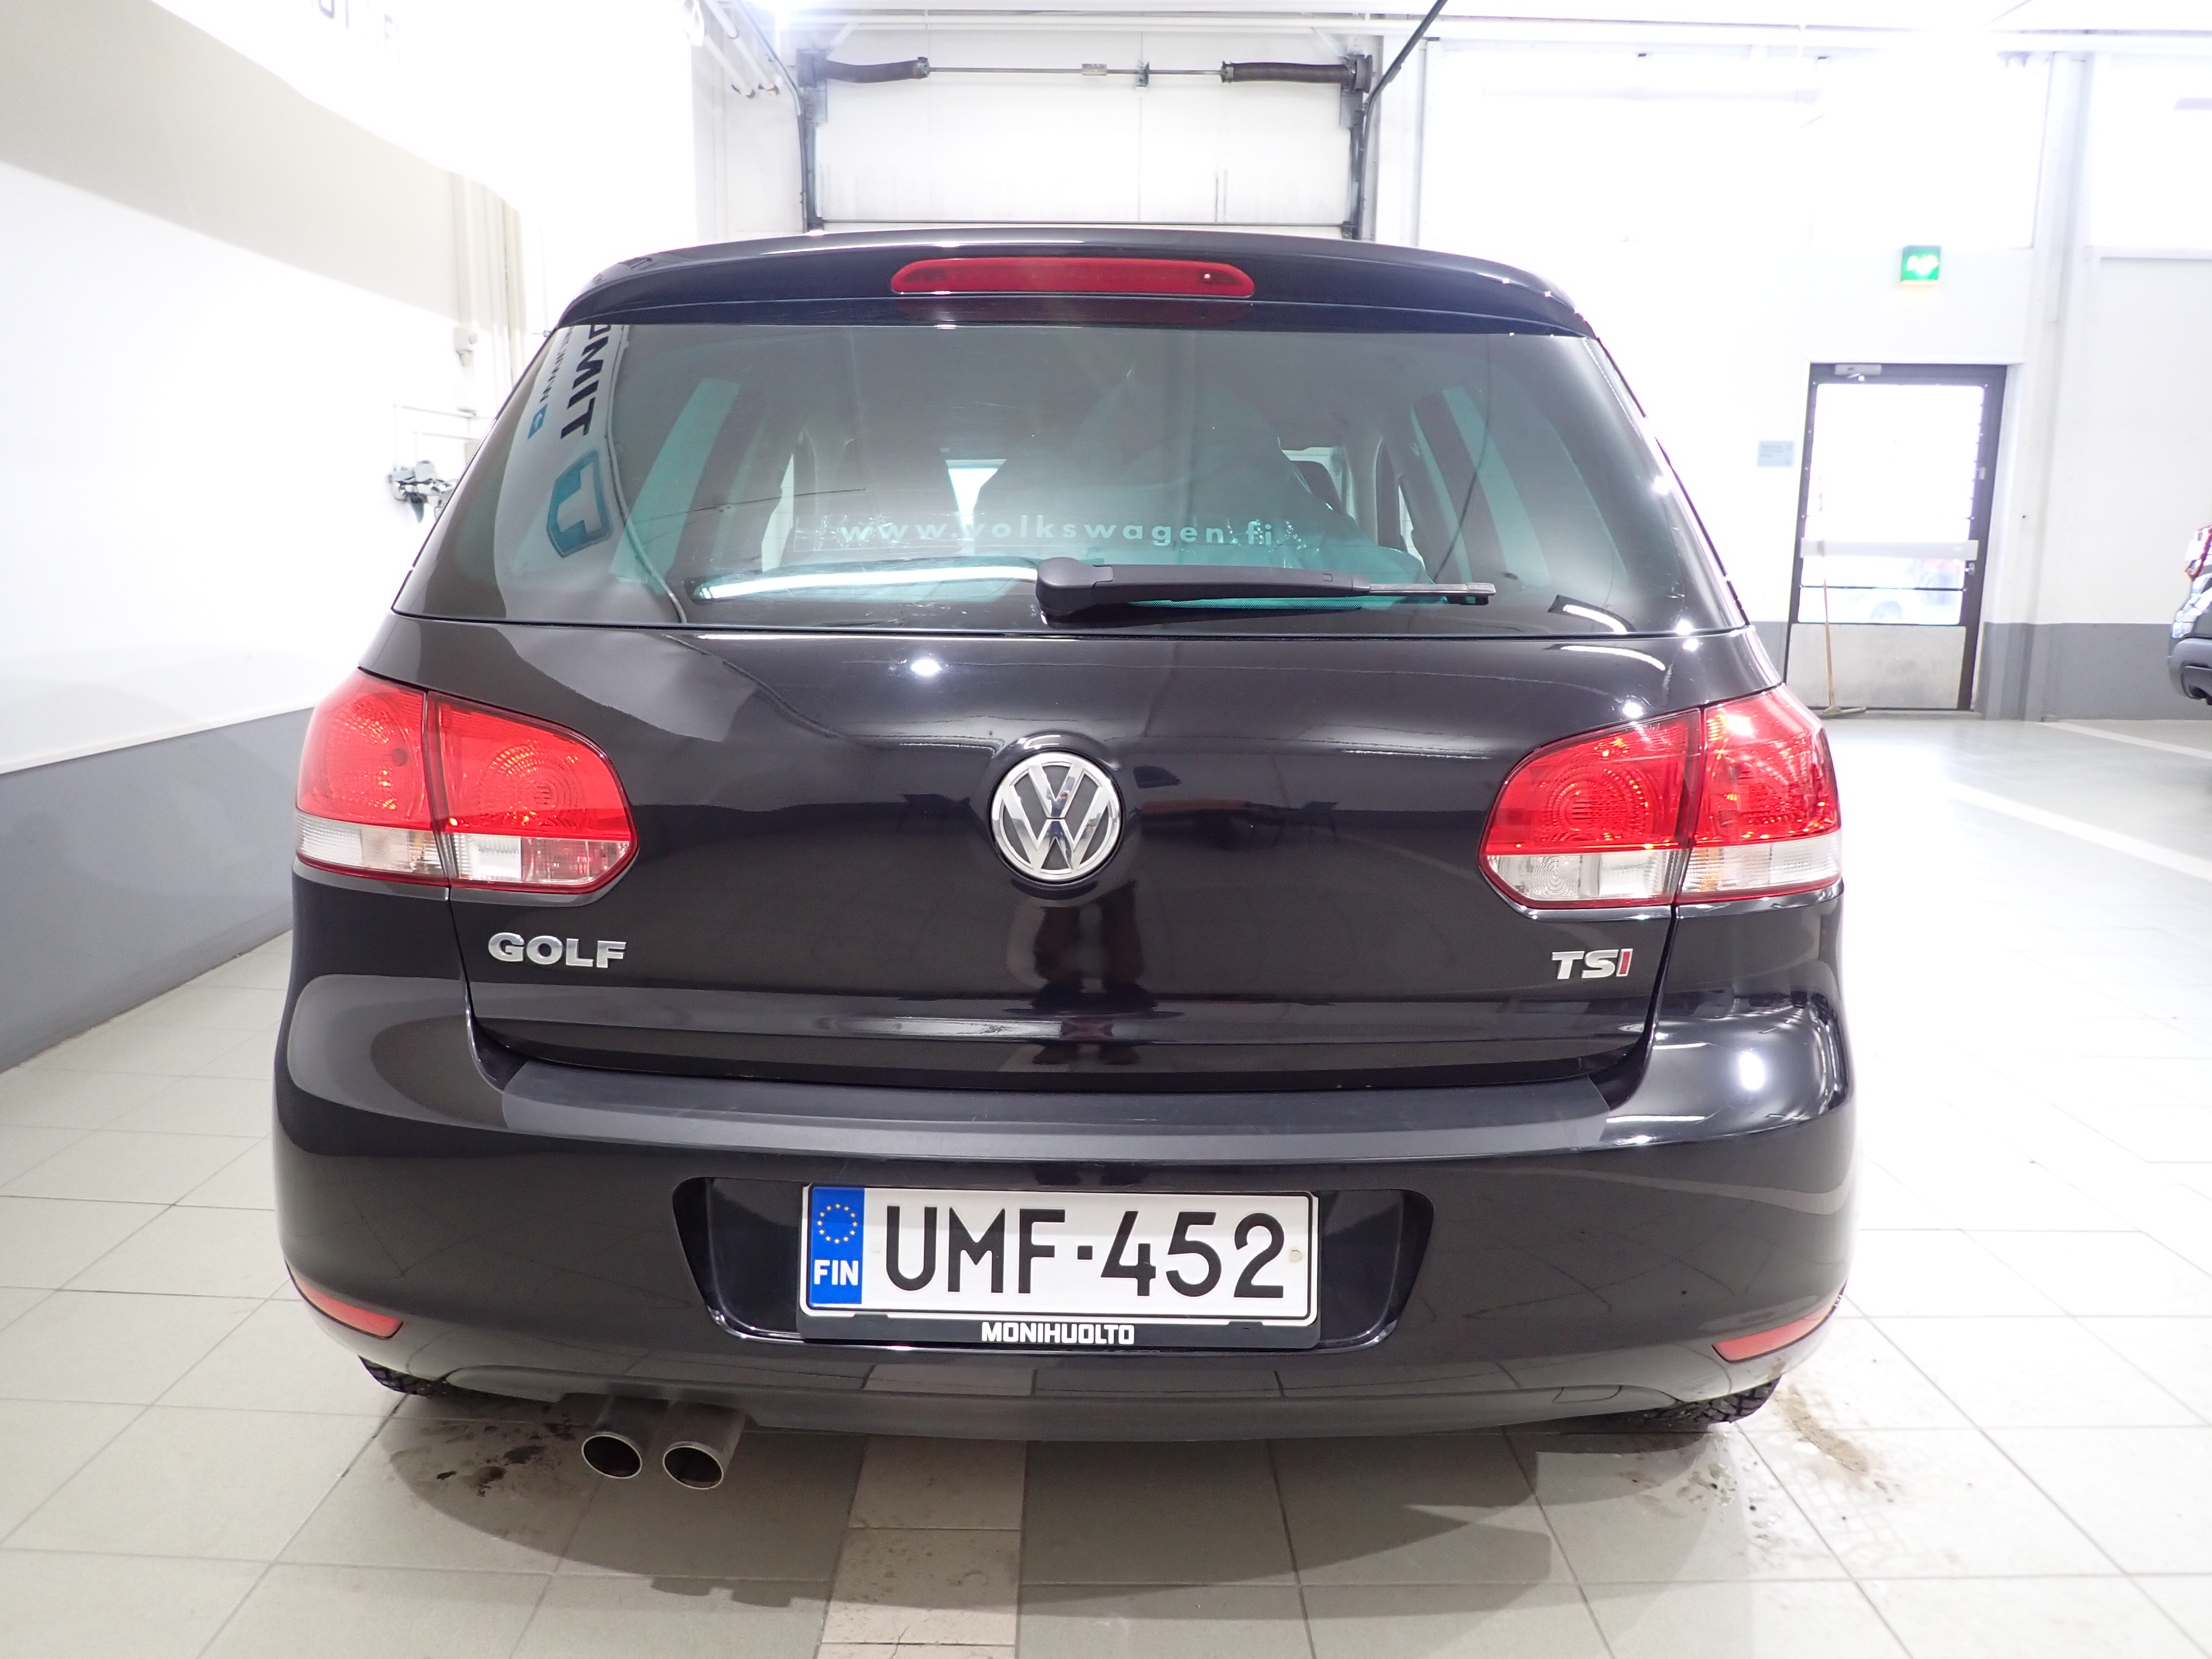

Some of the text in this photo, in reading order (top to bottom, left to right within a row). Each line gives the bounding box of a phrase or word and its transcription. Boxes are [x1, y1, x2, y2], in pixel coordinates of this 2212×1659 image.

[841, 514, 1272, 546] www.volkswagen.fi
[488, 932, 627, 968] GOLF
[1552, 948, 1634, 979] TSI
[886, 1204, 1285, 1298] UMF-452
[814, 1259, 859, 1286] FIN
[982, 1321, 1135, 1344] MONIHUOLTO
